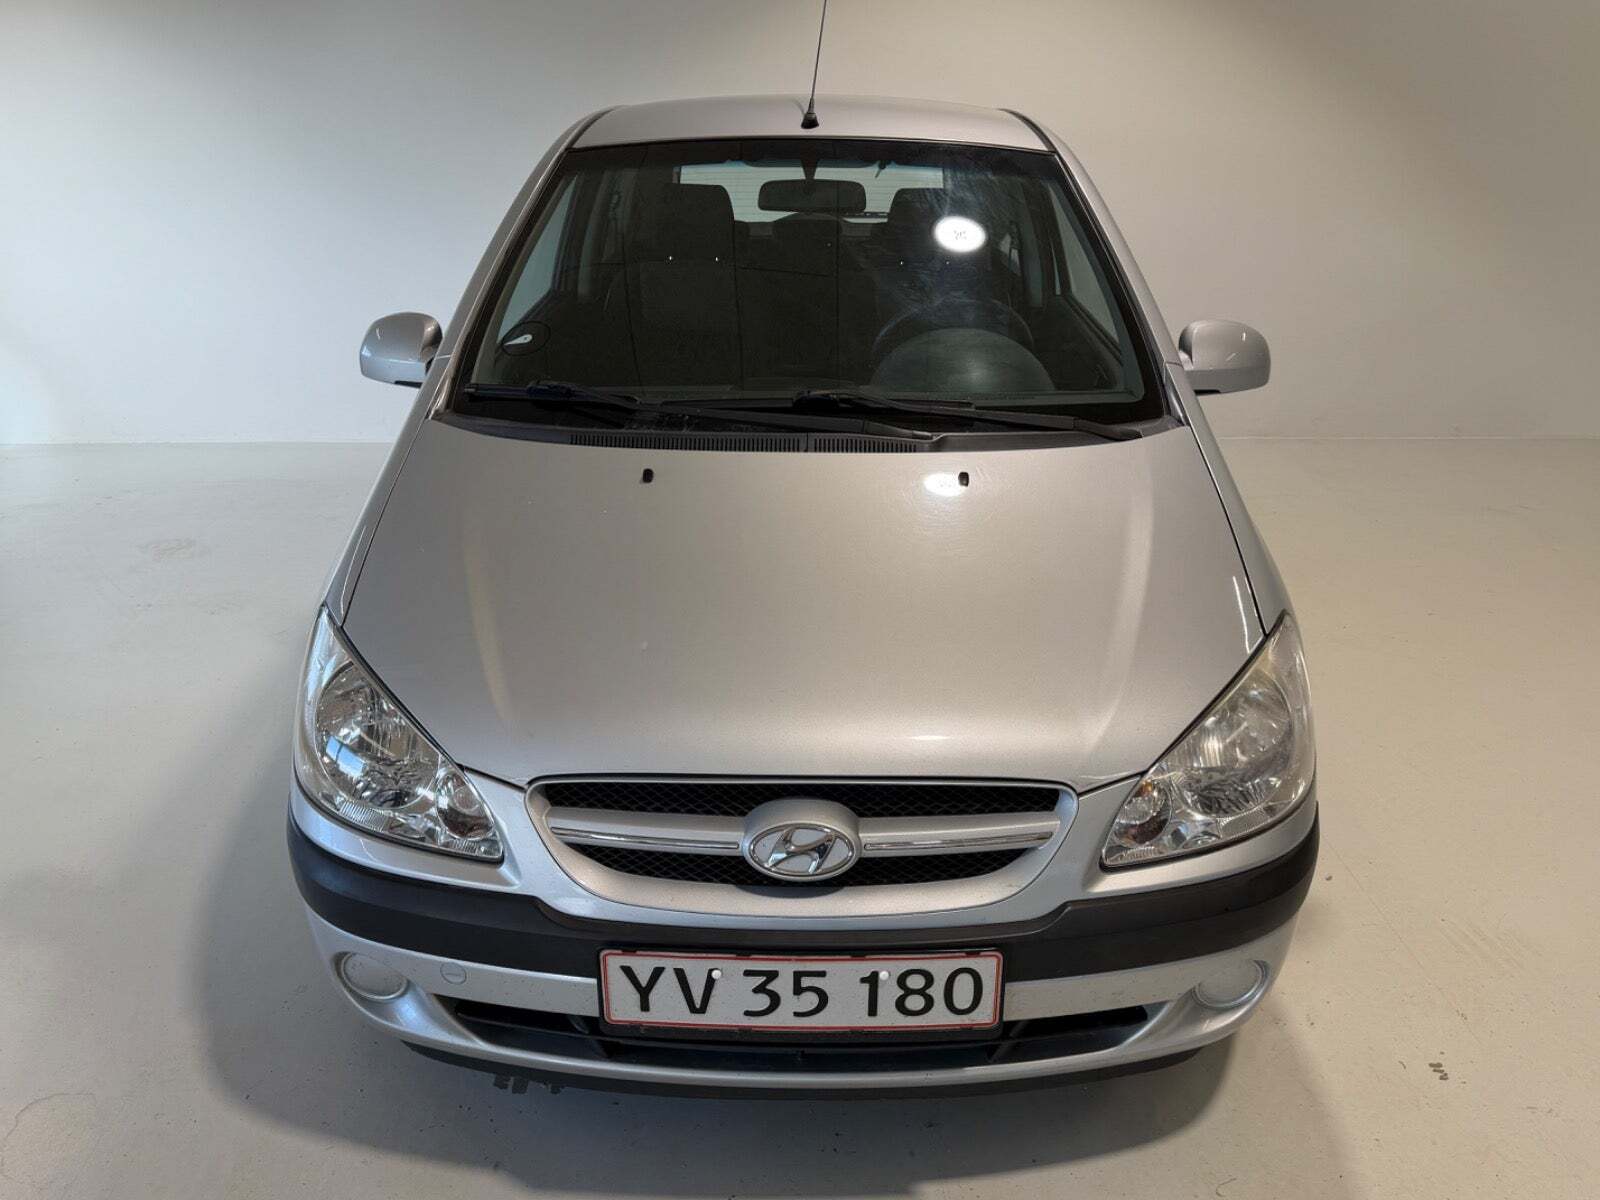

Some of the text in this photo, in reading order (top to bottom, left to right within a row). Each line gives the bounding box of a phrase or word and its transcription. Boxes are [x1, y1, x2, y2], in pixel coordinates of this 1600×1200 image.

[619, 964, 984, 1017] YV 35 180
